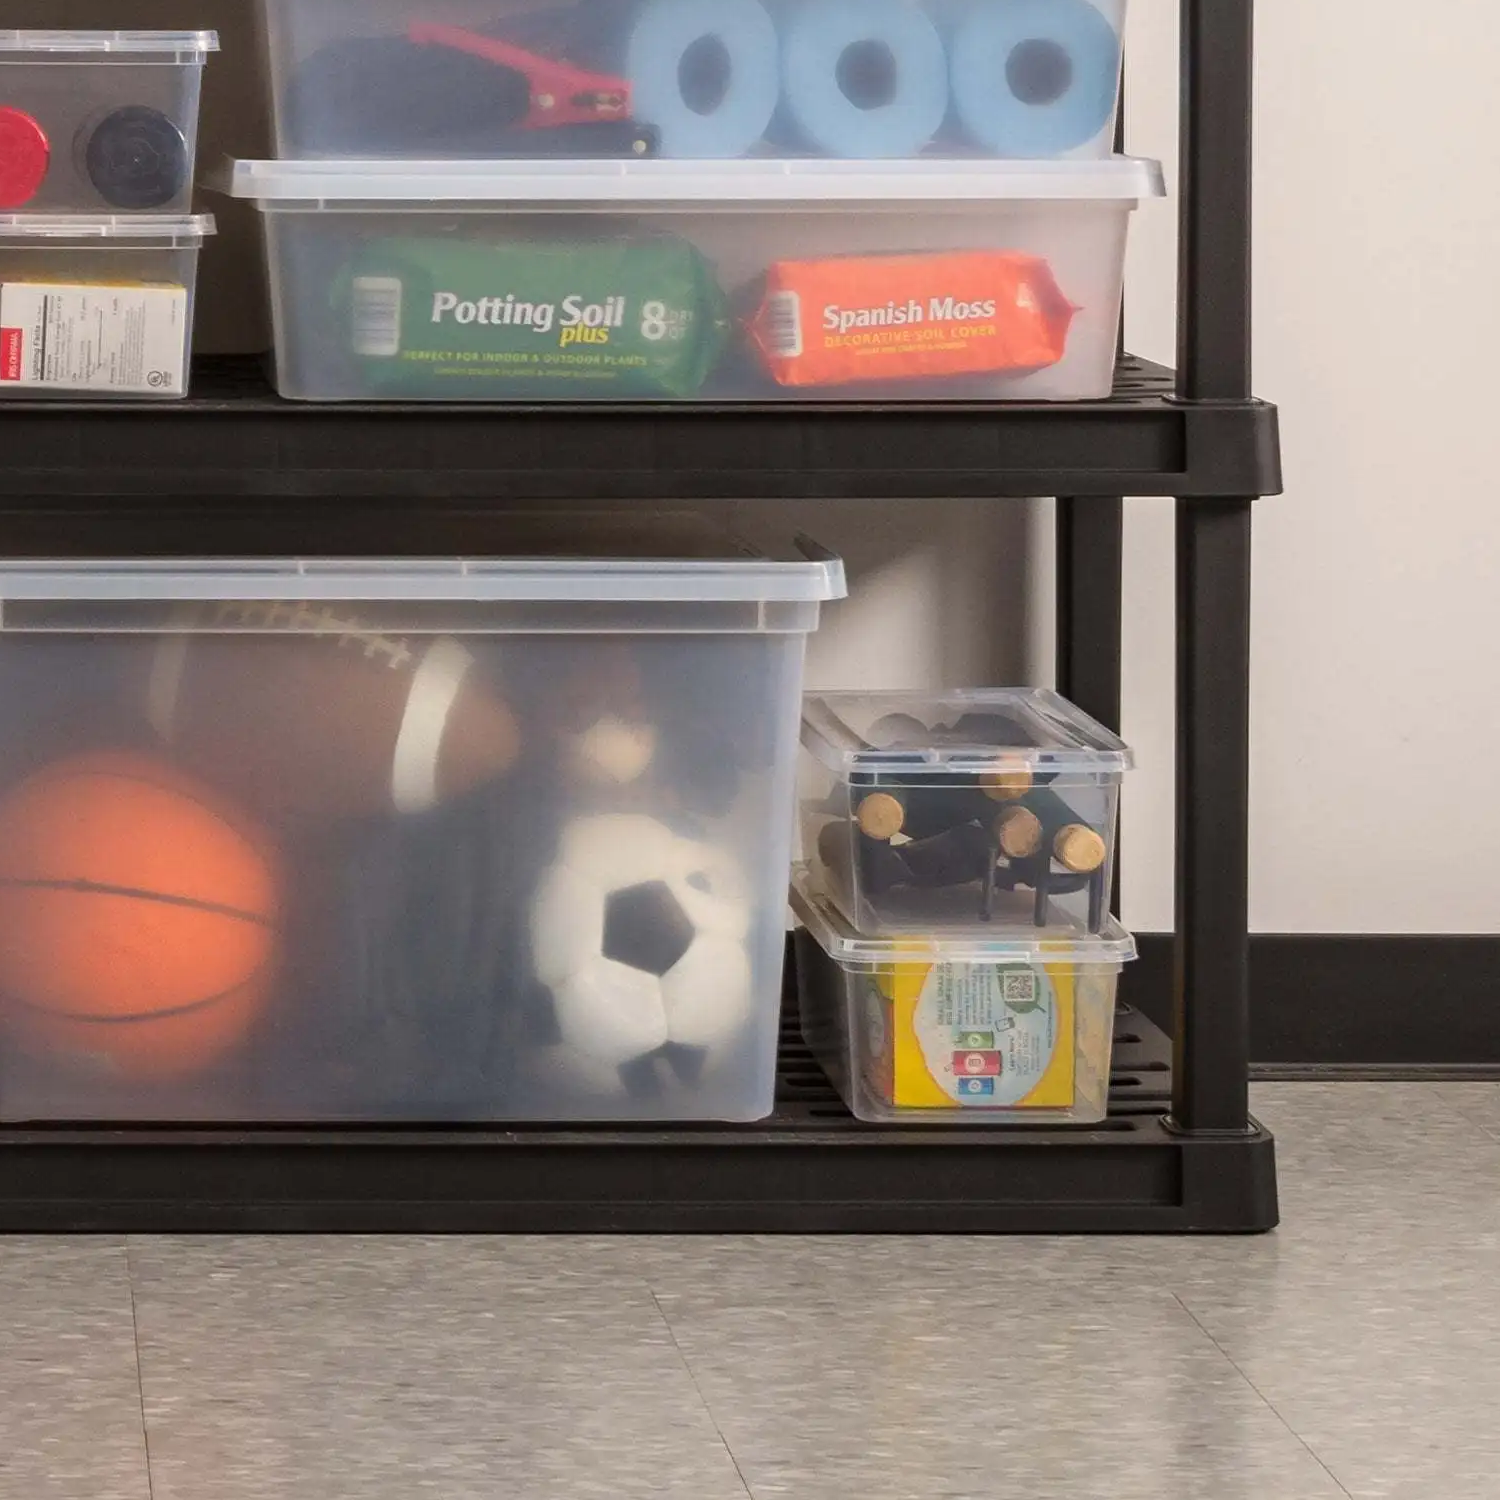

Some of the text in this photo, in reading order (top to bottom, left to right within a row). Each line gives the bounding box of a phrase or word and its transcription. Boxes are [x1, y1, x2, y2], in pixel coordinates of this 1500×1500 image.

[431, 292, 626, 333] Potting Soil
[641, 301, 666, 341] 8
[823, 297, 996, 334] Spanish Moss
[560, 321, 610, 348] plus
[824, 324, 997, 348] DECORATIVE SOIL COVER
[456, 351, 479, 362] FOR
[482, 352, 529, 363] INDOOR
[542, 354, 600, 365] OUTDOOR
[604, 354, 648, 366] PLANTS
